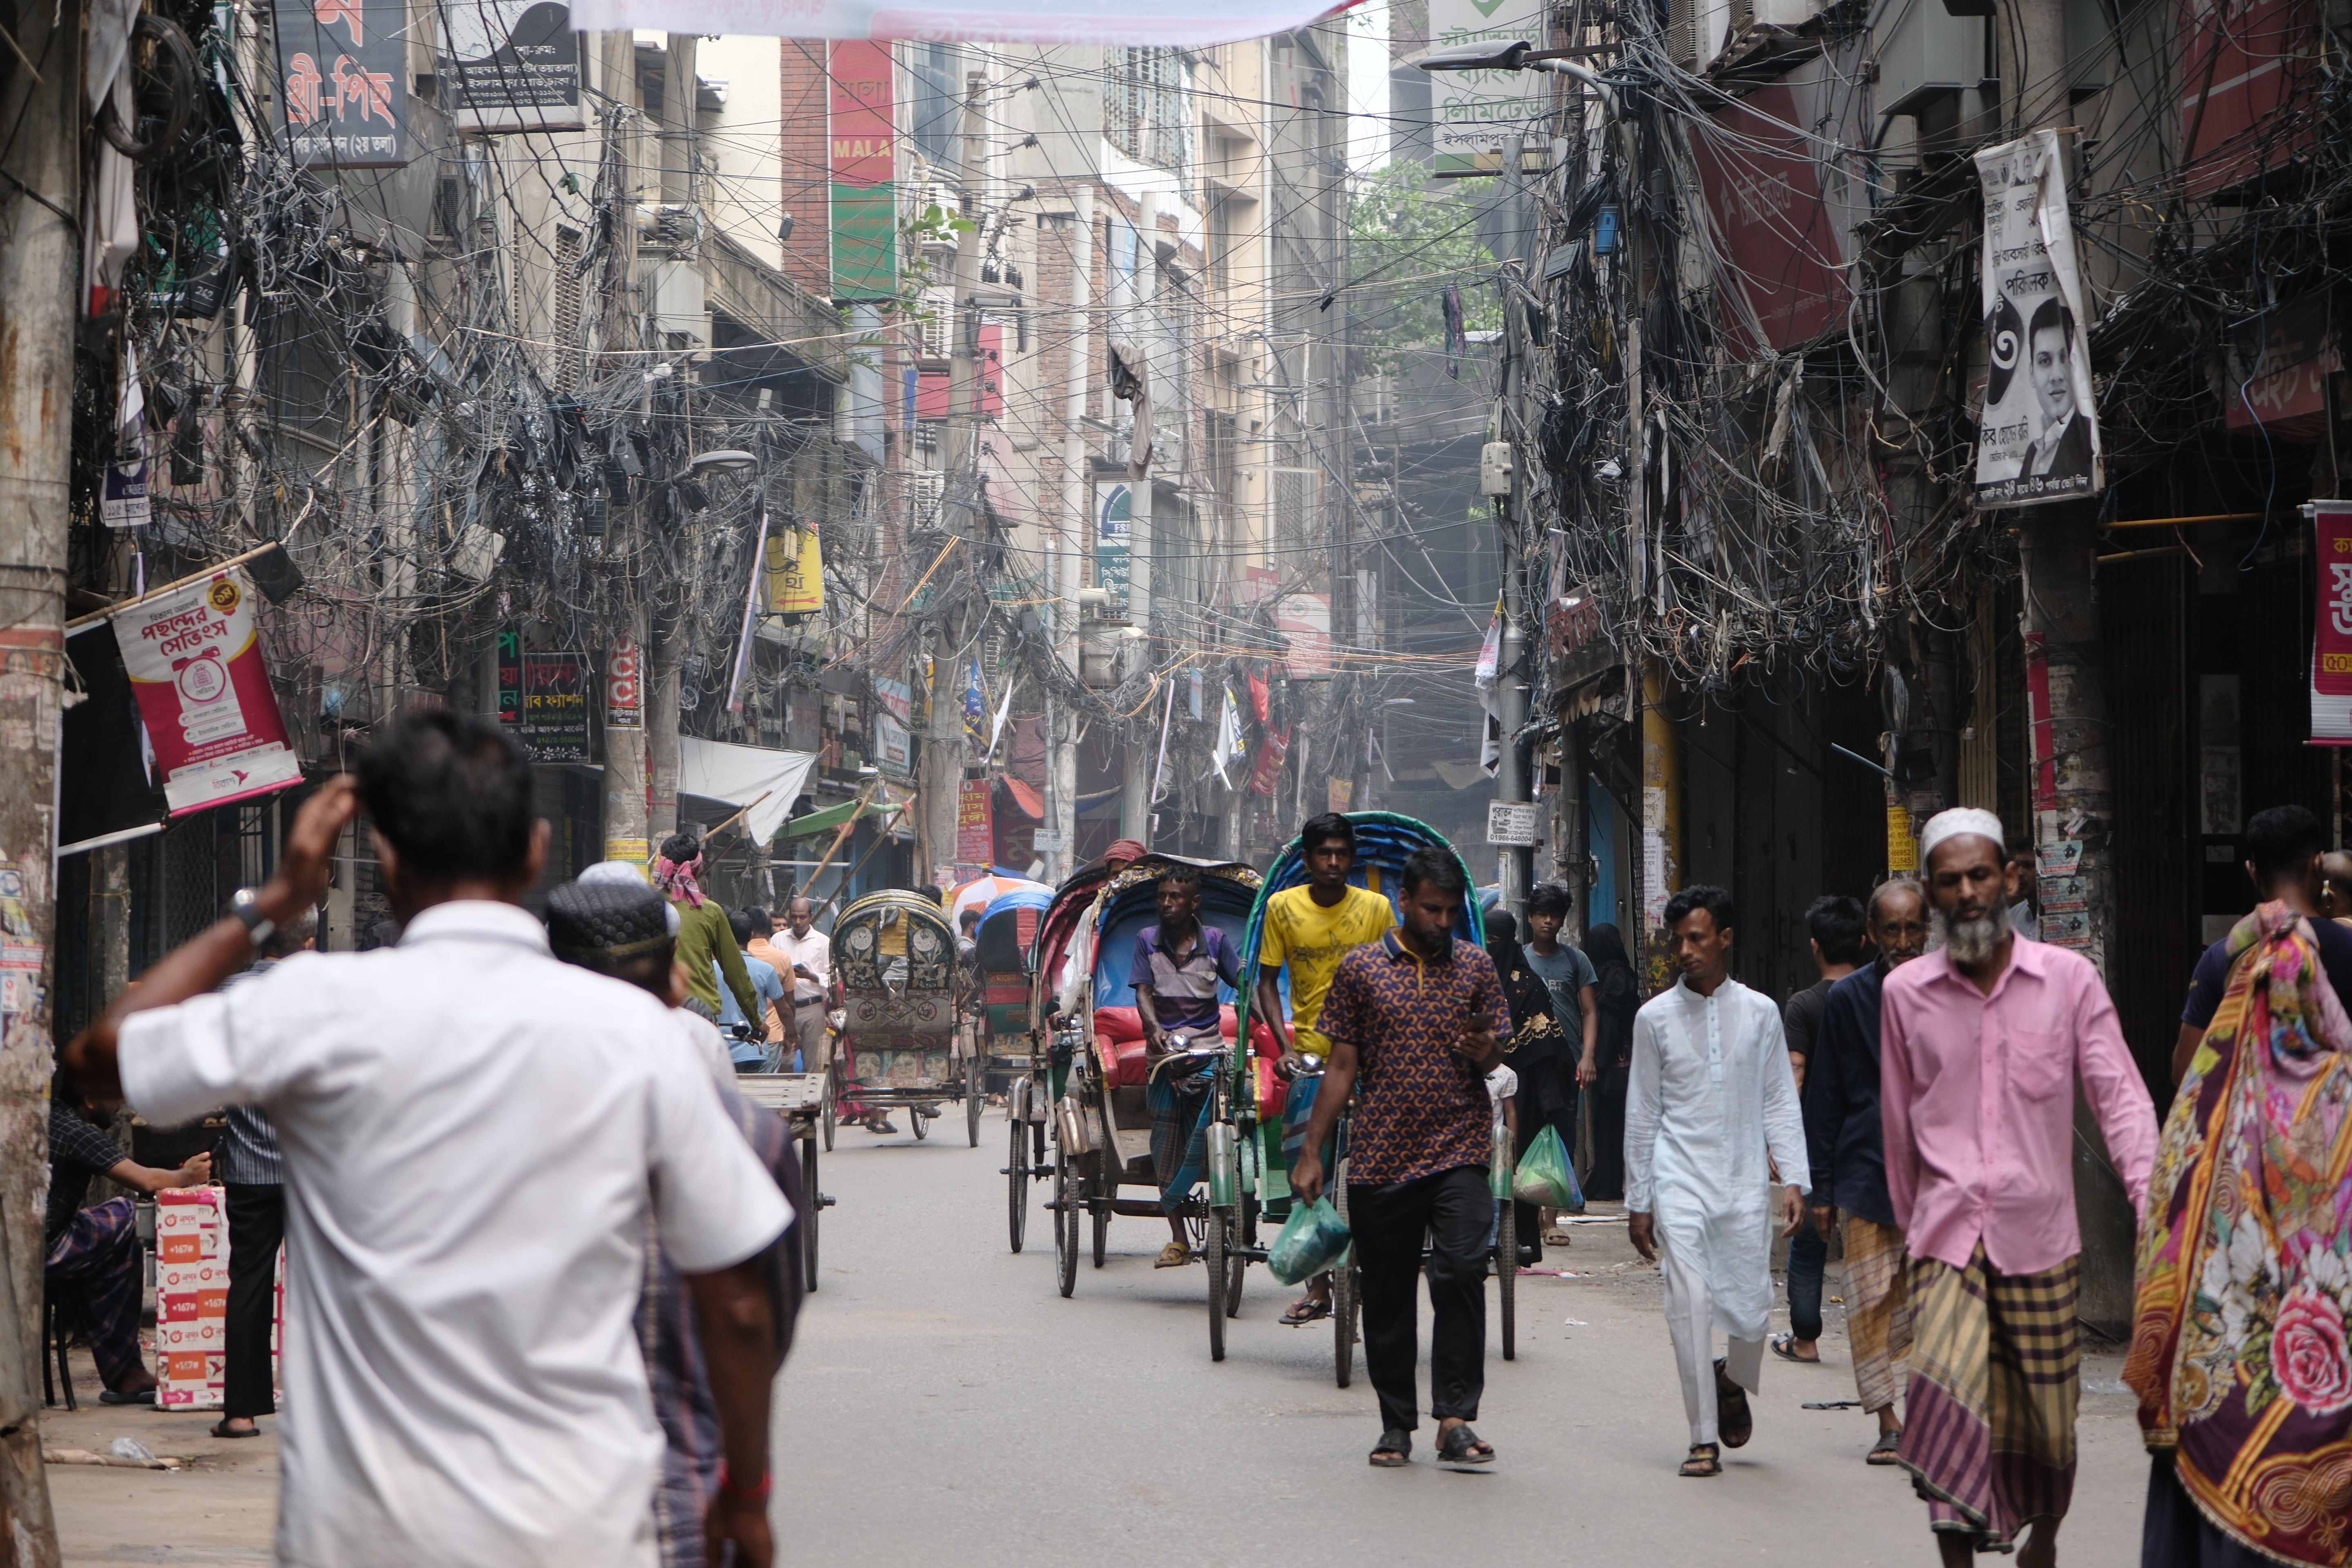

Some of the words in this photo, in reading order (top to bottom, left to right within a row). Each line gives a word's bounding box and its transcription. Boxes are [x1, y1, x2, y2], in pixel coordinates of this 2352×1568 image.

[834, 140, 891, 158] MALA
[141, 606, 208, 639] পছন্দের
[160, 619, 228, 656] সেভিংস
